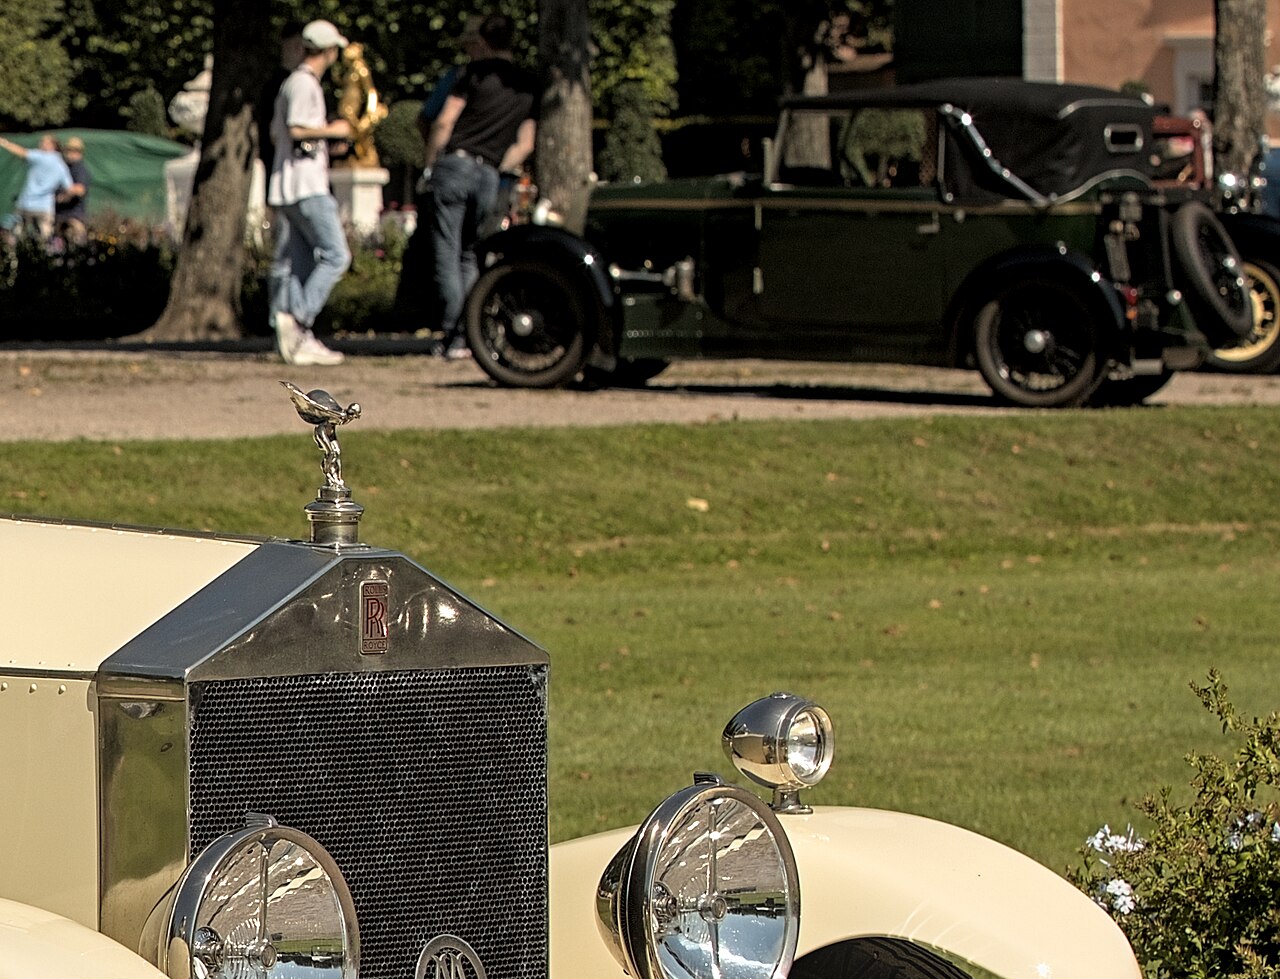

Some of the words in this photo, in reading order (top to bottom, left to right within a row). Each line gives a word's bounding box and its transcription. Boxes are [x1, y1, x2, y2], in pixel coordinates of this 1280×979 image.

[365, 585, 387, 595] ROLLS
[366, 598, 385, 638] RR
[363, 641, 386, 650] ROYCE
